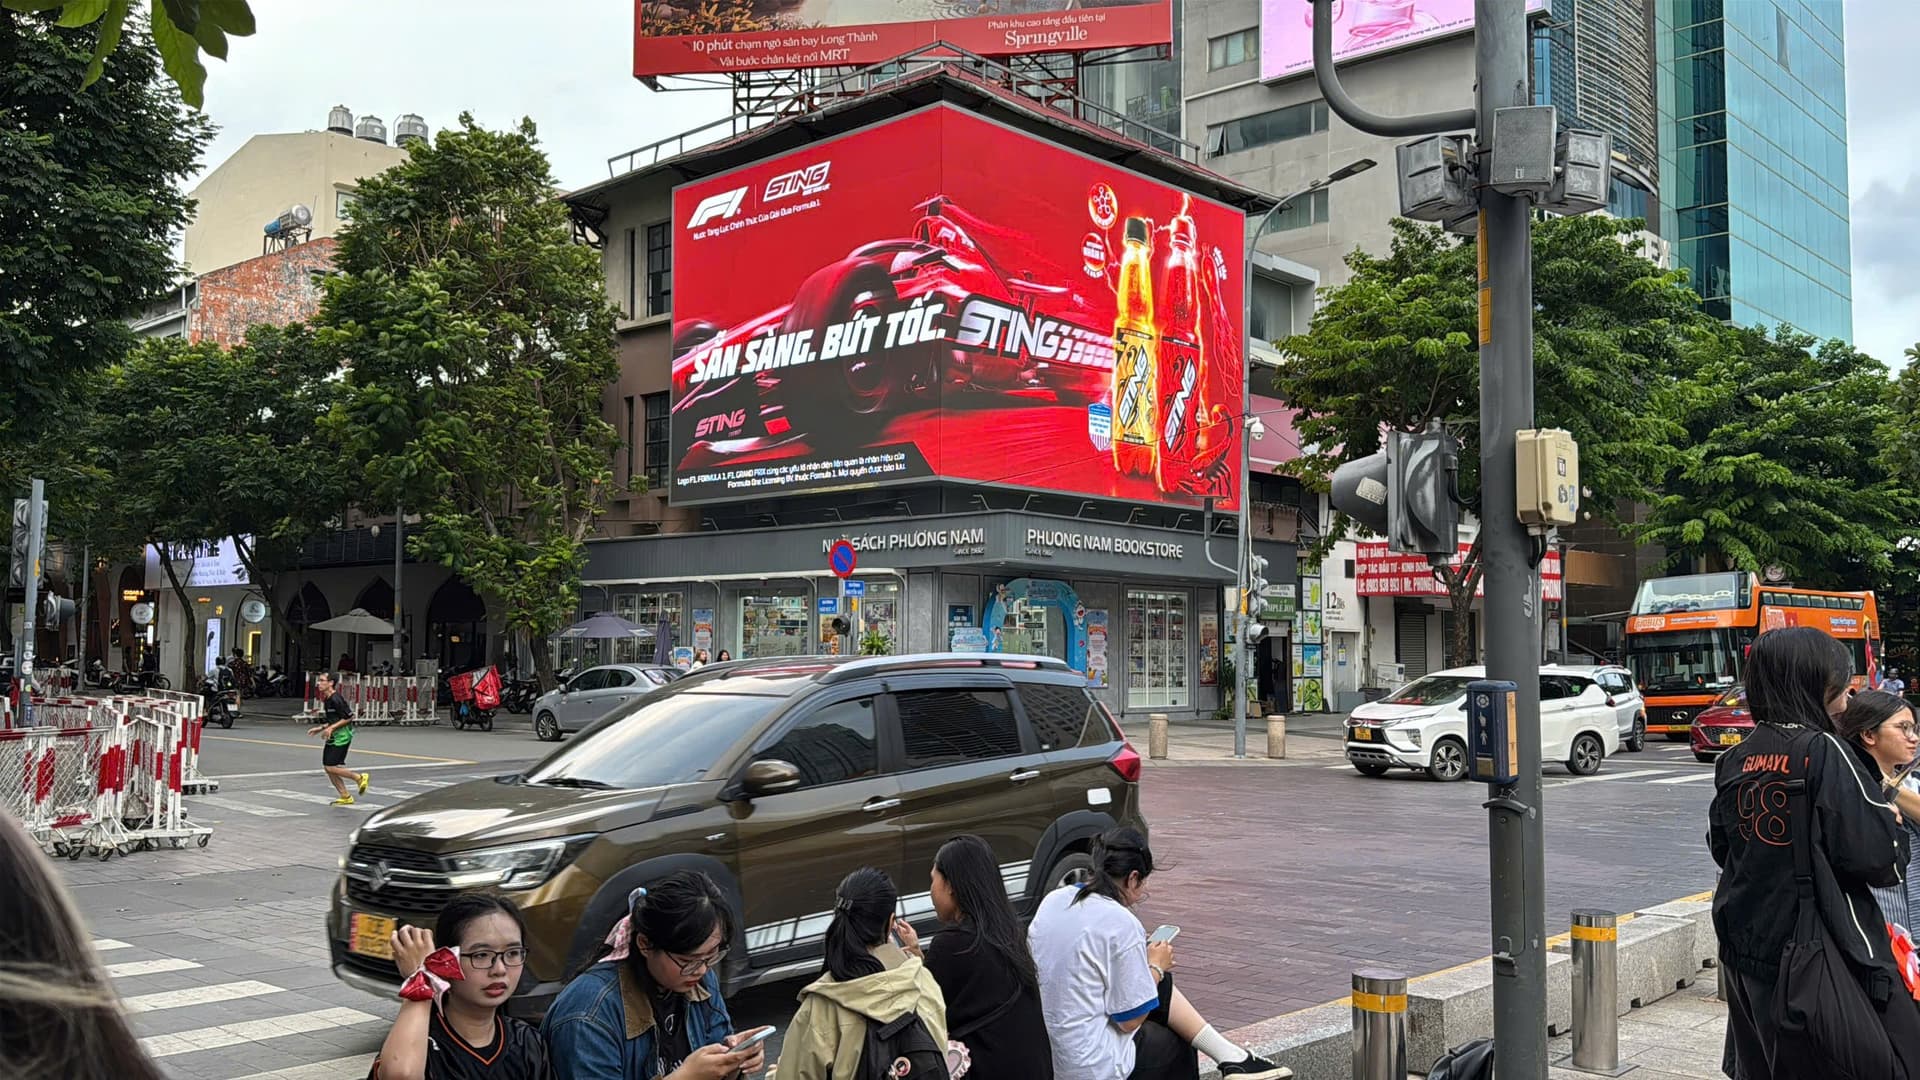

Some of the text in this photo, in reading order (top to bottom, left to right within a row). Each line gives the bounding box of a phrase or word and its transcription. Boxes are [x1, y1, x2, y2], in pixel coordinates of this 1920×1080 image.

[1004, 26, 1088, 48] Springville
[1009, 18, 1025, 28] khu
[1026, 18, 1041, 27] cao
[692, 42, 704, 52] 10
[706, 38, 732, 55] phút
[801, 34, 820, 49] bay
[821, 33, 845, 48] Long
[847, 31, 878, 44] Thành
[820, 50, 850, 62] MRT
[687, 161, 831, 229] F1 STING
[820, 308, 881, 361] BỨT
[884, 290, 948, 349] TỐC.
[957, 299, 1064, 360] STING
[1164, 354, 1197, 453] STING
[695, 409, 746, 437] STING
[852, 532, 886, 552] SÁCH
[890, 531, 946, 550] PHƯƠNG
[950, 528, 984, 547] NAM
[1027, 529, 1183, 559] PHUONG NAM BOOKSTORE
[1738, 780, 1793, 846] 98
